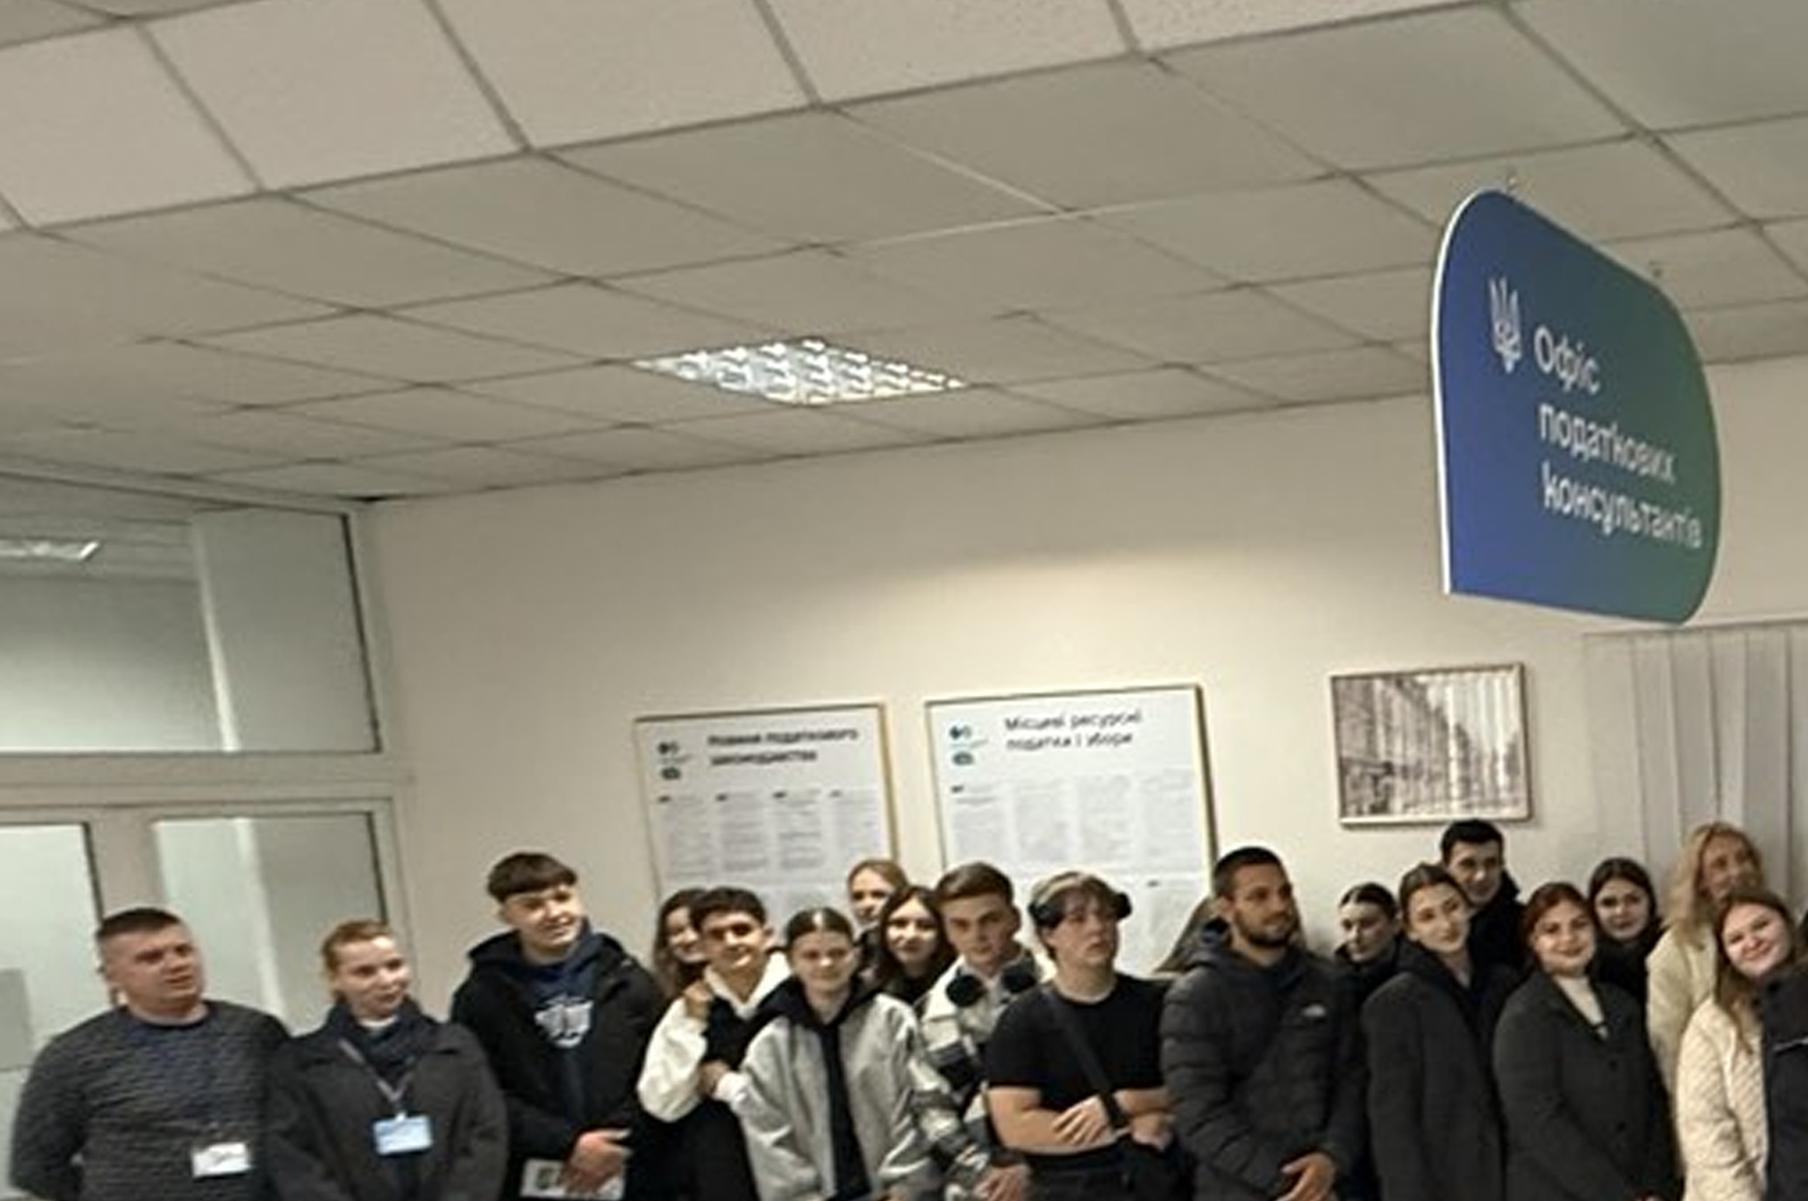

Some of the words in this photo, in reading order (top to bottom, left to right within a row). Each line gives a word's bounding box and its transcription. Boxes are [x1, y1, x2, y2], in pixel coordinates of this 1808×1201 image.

[1533, 327, 1600, 393] Офіс
[1538, 403, 1676, 484] податкових
[1541, 462, 1702, 549] консультантів
